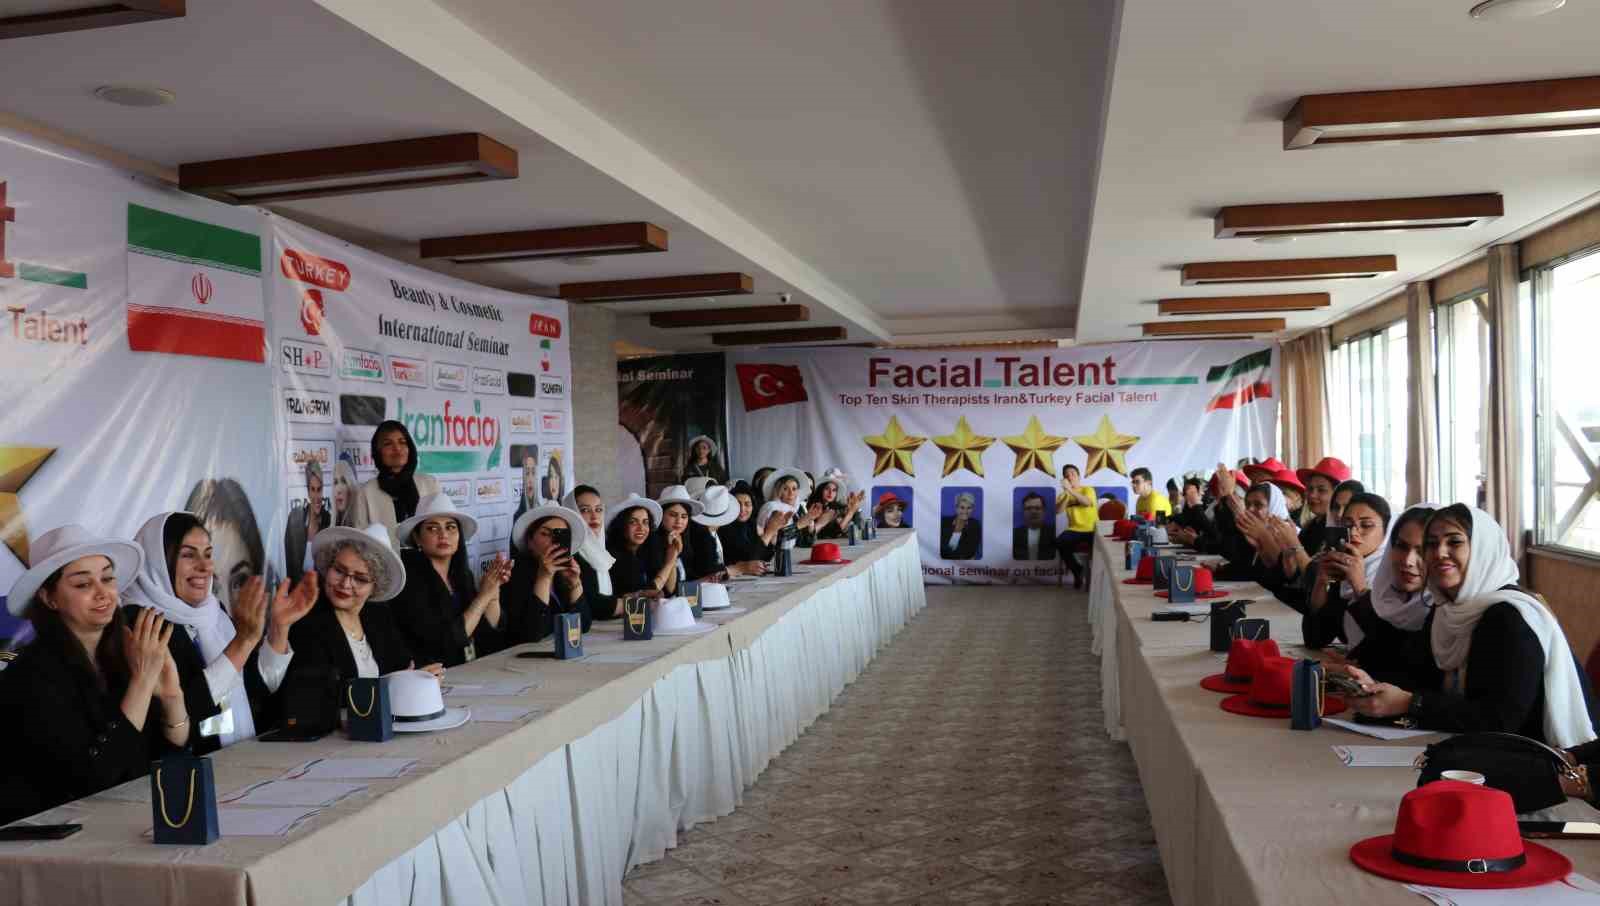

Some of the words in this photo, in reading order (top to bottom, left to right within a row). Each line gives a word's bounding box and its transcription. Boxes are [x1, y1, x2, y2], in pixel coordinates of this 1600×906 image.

[284, 256, 348, 288] TURKEY
[390, 279, 436, 312] Beauty
[439, 292, 449, 310] &
[450, 296, 504, 322] Cosmetic
[8, 306, 88, 346] Talent
[378, 314, 465, 349] International
[467, 331, 510, 356] Seminar
[638, 367, 694, 382] Seminar
[869, 357, 982, 388] Facial
[995, 355, 1116, 387] Talent
[839, 394, 863, 406] Top
[866, 394, 888, 405] Ten
[892, 394, 919, 405] Skin
[922, 393, 990, 406] Therapists
[1075, 391, 1114, 404] Facial
[1119, 391, 1158, 402] Talent
[959, 565, 1010, 577] seminar
[1014, 567, 1030, 577] on
